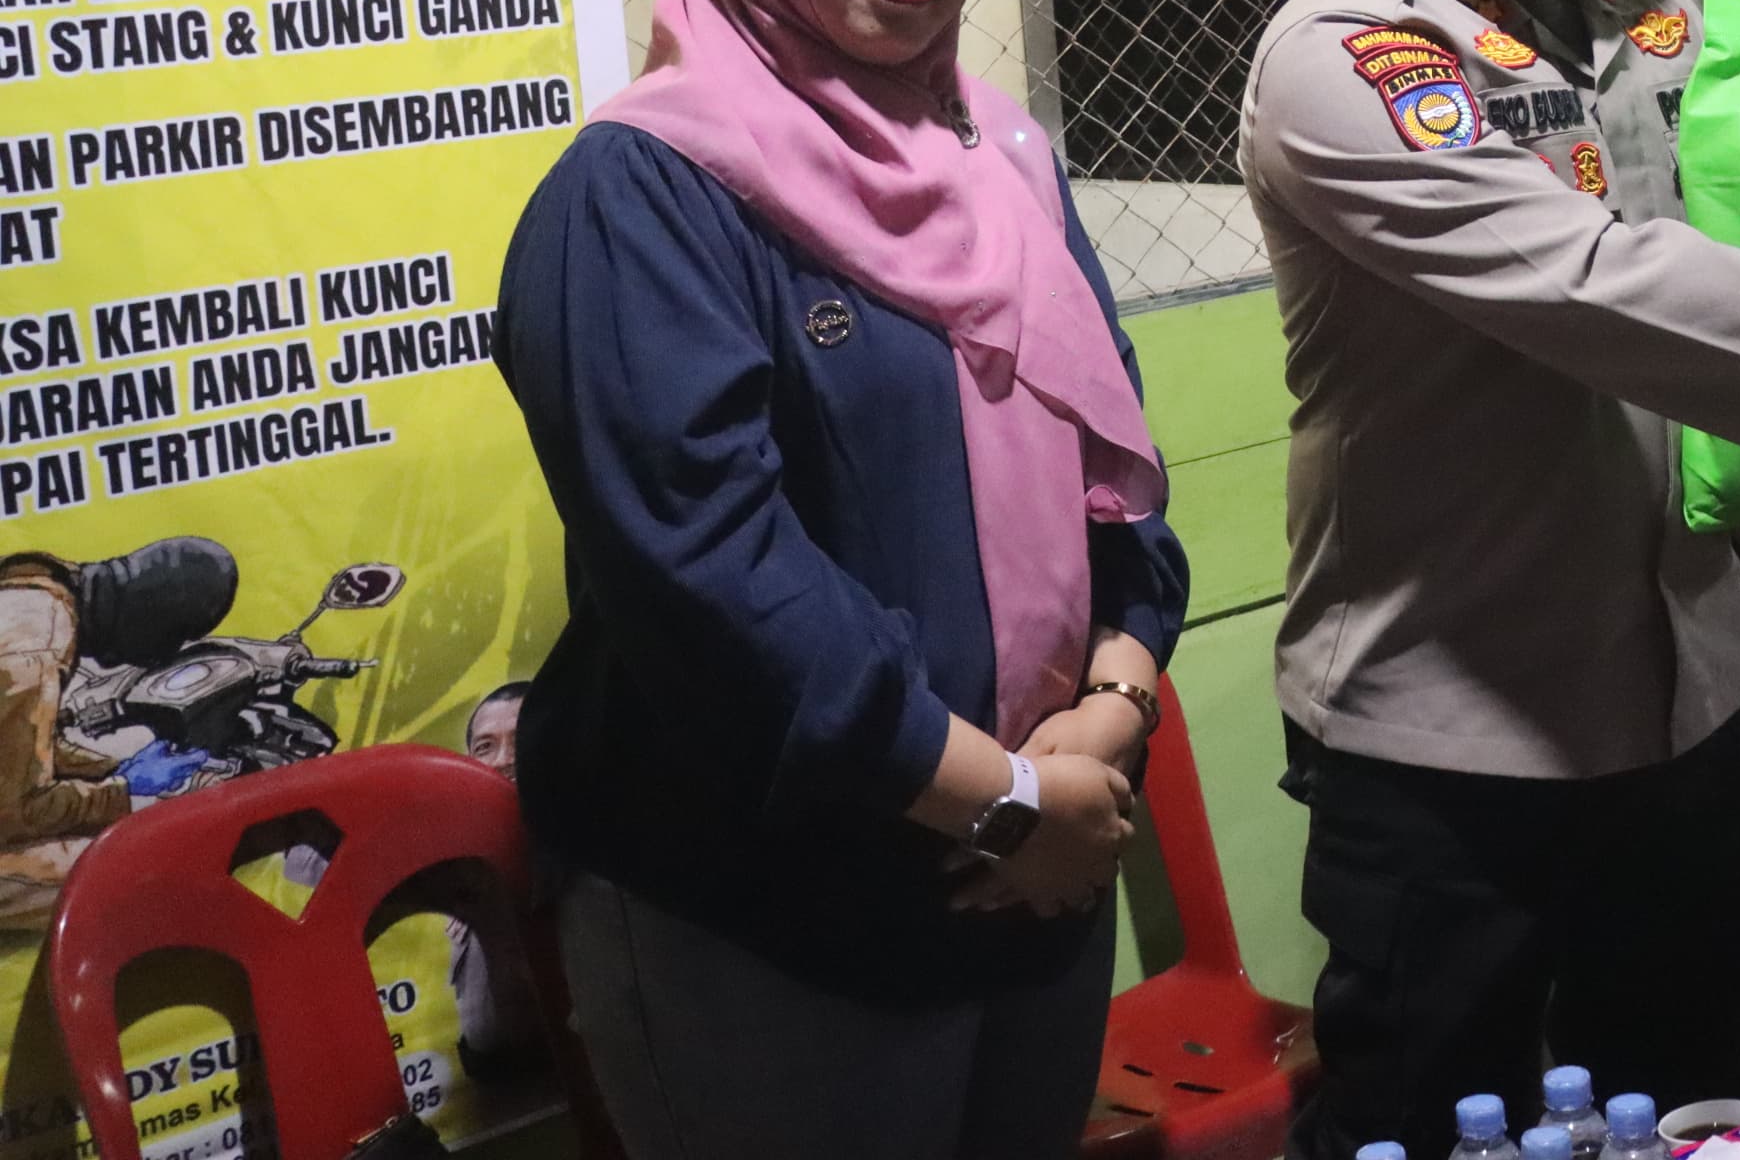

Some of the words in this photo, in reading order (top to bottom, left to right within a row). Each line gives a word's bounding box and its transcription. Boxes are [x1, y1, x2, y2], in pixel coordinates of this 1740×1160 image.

[50, 10, 209, 73] STANG
[226, 11, 257, 56] &
[1388, 68, 1453, 95] BINMAS
[70, 116, 243, 185] PARKIR
[259, 78, 571, 163] DISEMBARANG
[0, 207, 58, 265] AT
[96, 277, 303, 359] KEMBALI
[321, 255, 452, 323] KUNCI
[0, 366, 176, 444] ARAAN
[193, 342, 316, 411] ANDA
[330, 311, 497, 385] JANGAN
[0, 450, 85, 516] PAI
[99, 398, 391, 496] TERTINGGAL.
